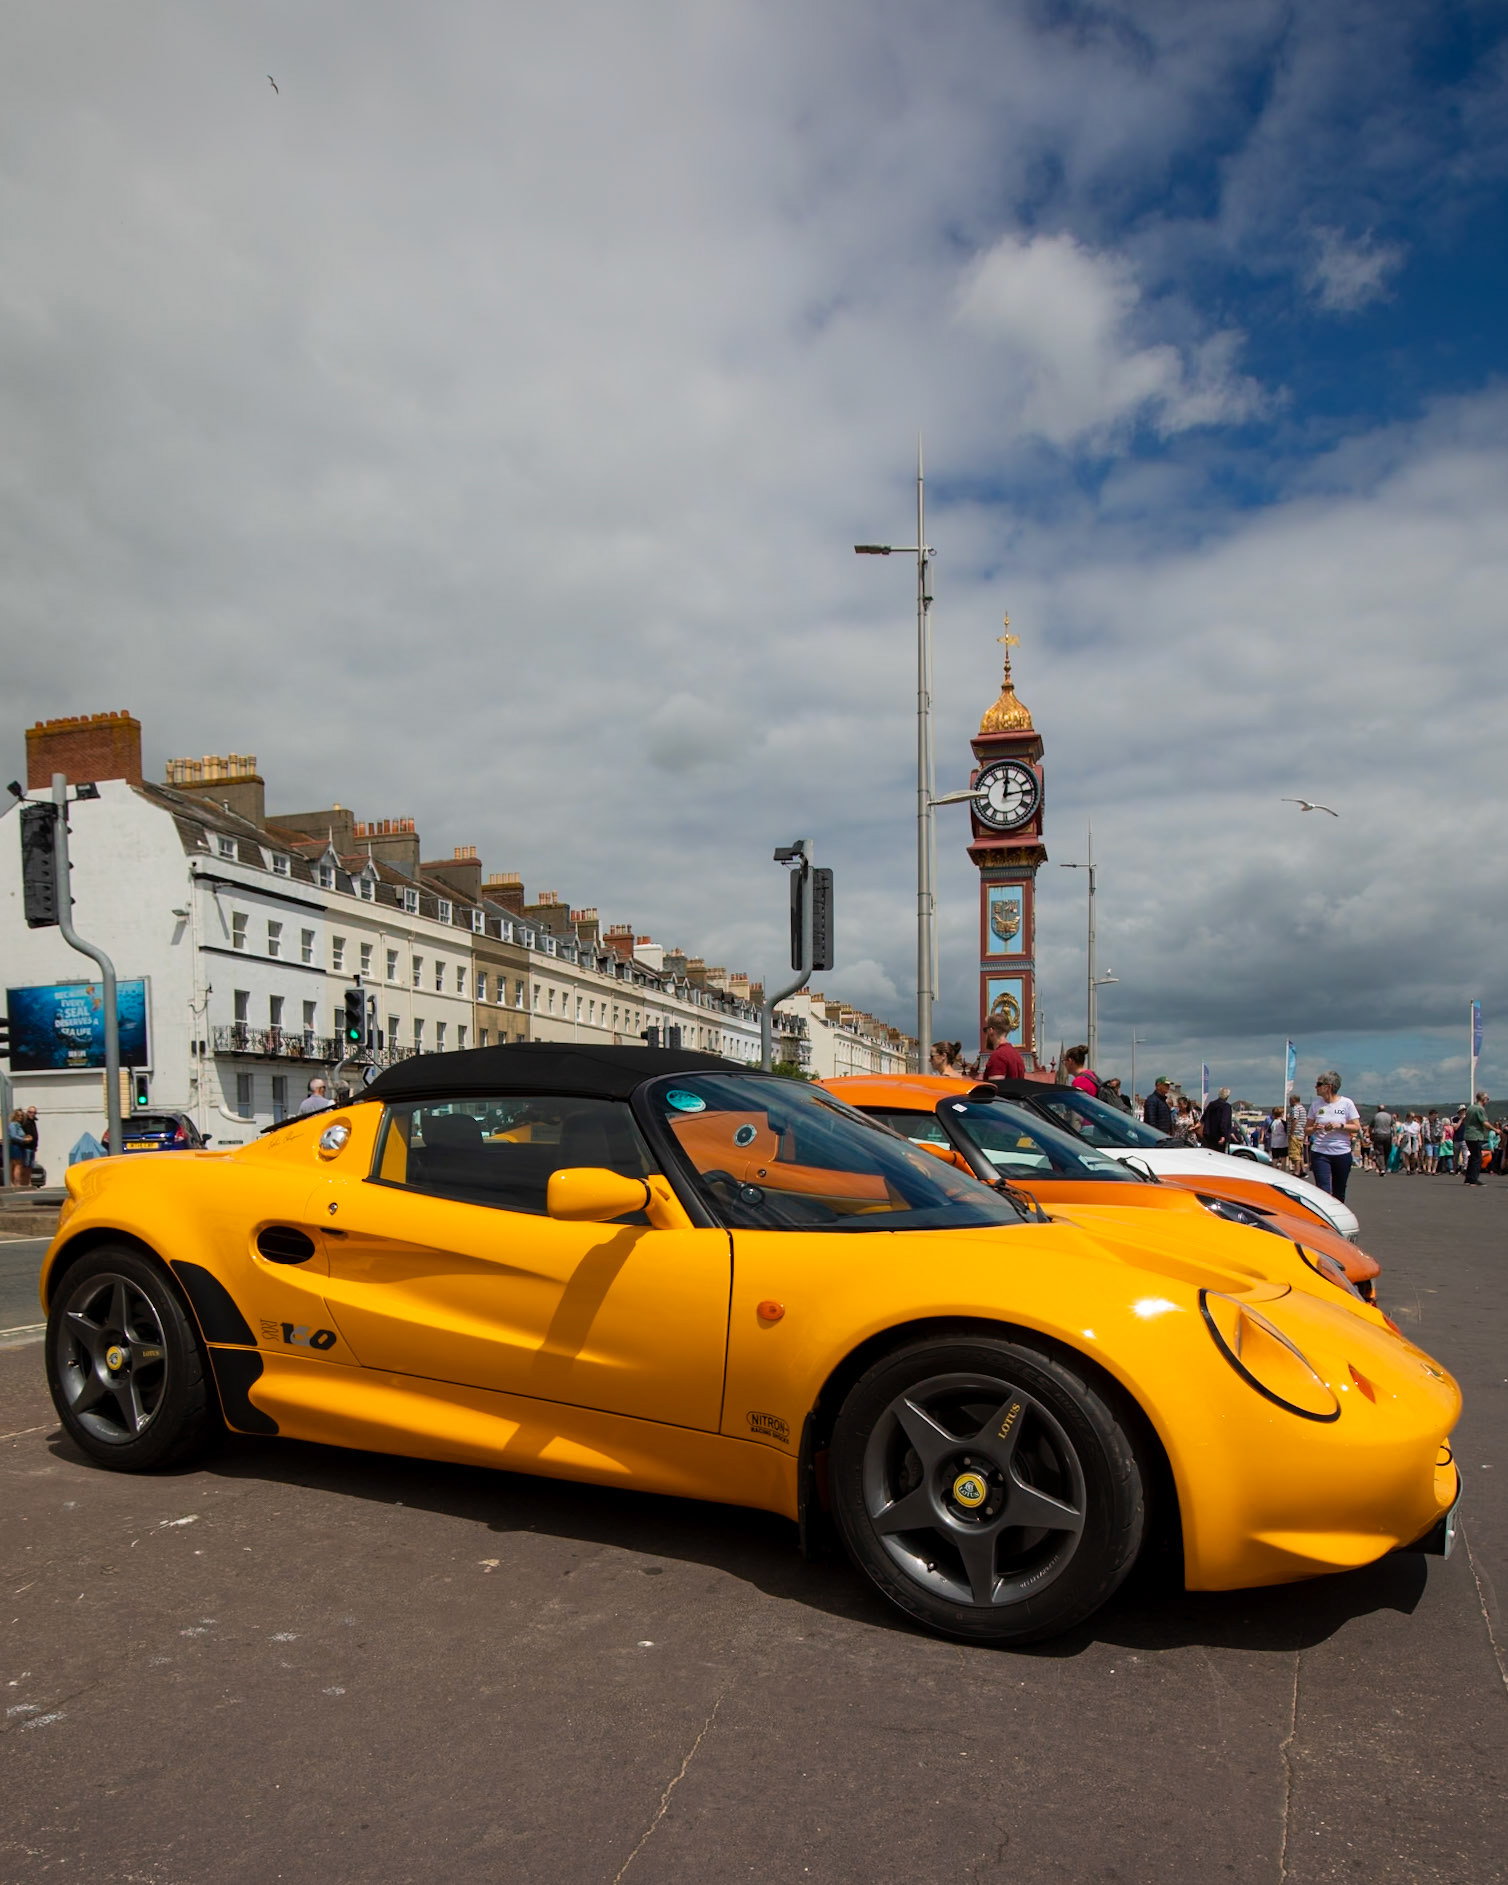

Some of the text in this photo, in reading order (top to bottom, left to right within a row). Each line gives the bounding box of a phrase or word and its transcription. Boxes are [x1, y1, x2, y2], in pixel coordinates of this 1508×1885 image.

[64, 1006, 90, 1018] SEAL
[93, 1018, 99, 1026] A
[280, 1322, 337, 1350] 160
[752, 1413, 785, 1433] NITRON
[998, 1402, 1021, 1439] LOTUS
[958, 1485, 981, 1498] LOTUS
